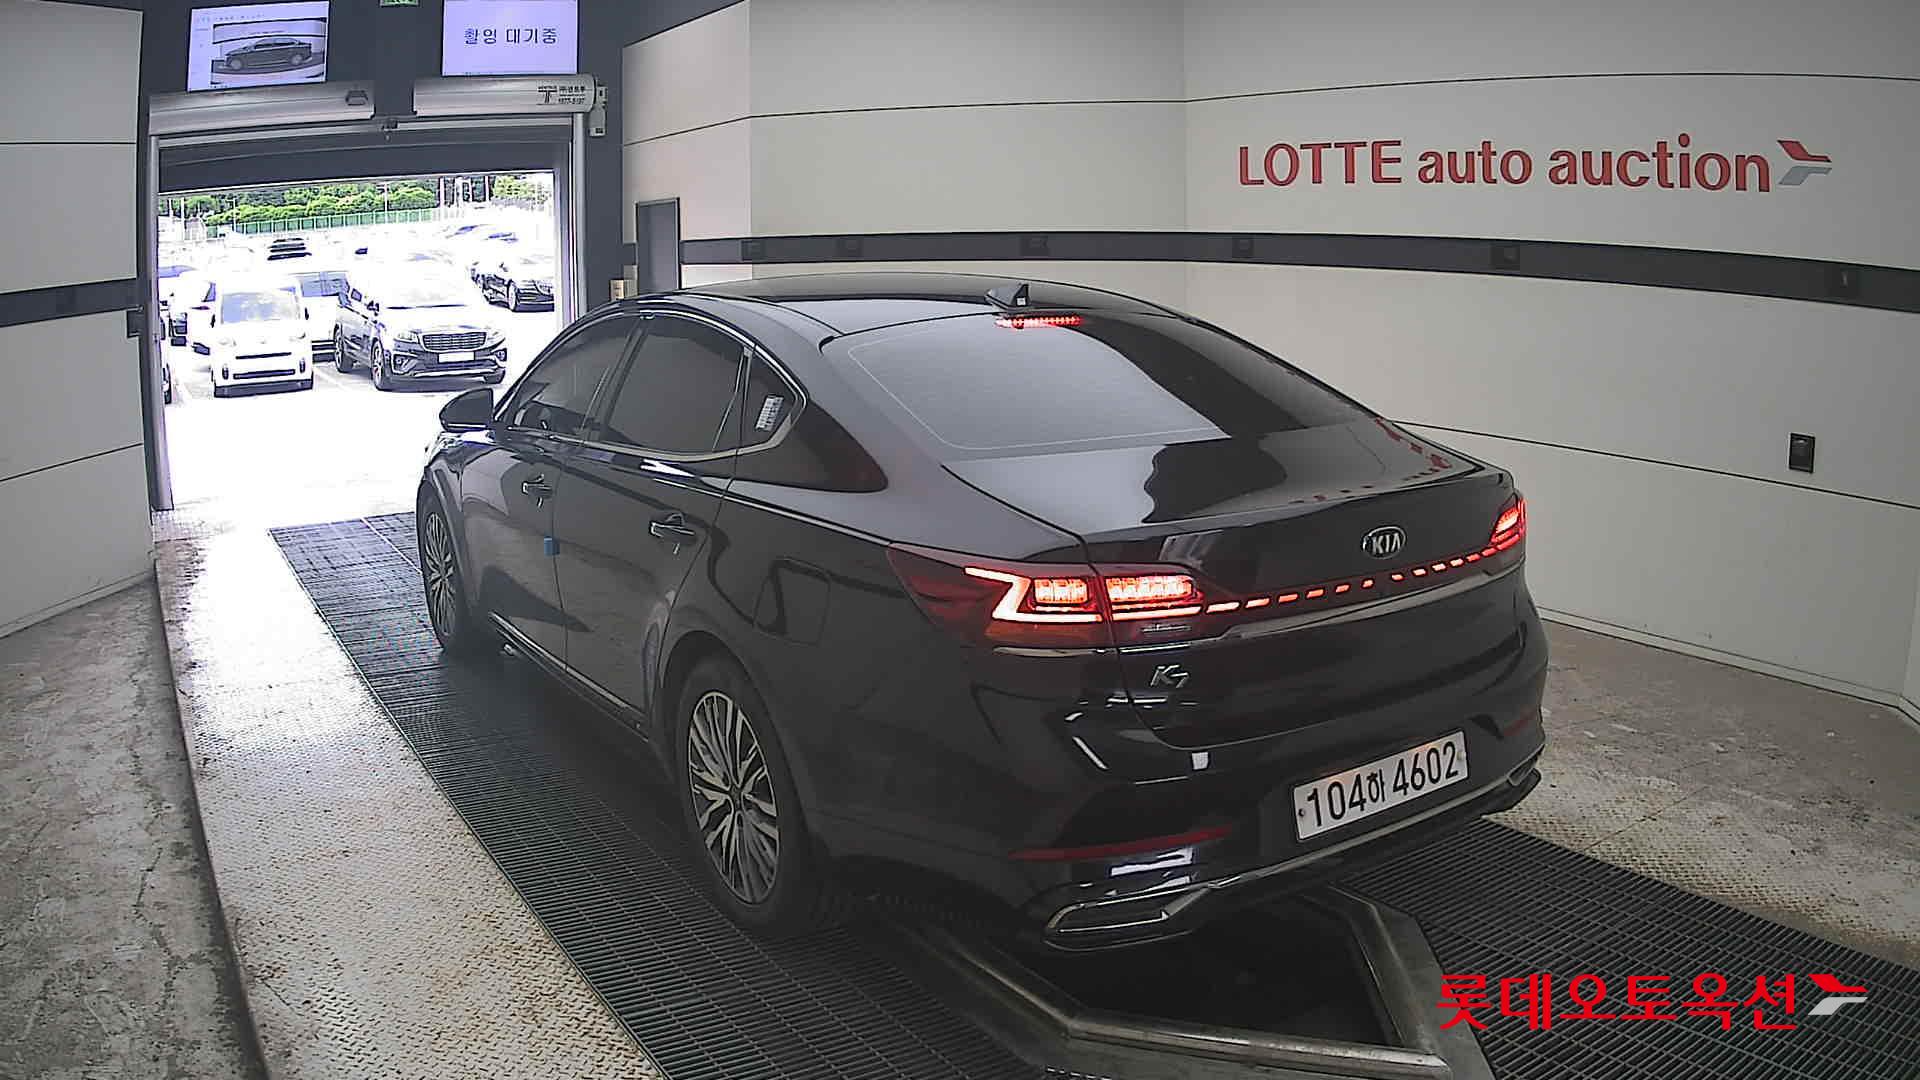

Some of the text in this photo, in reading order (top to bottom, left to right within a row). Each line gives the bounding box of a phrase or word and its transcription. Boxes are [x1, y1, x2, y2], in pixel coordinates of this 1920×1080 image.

[506, 28, 558, 45] 대기중
[1238, 132, 1772, 193] LOTTE auto auction
[1371, 532, 1402, 556] KIA
[1149, 664, 1191, 689] K7
[1306, 740, 1460, 828] 104하 4602
